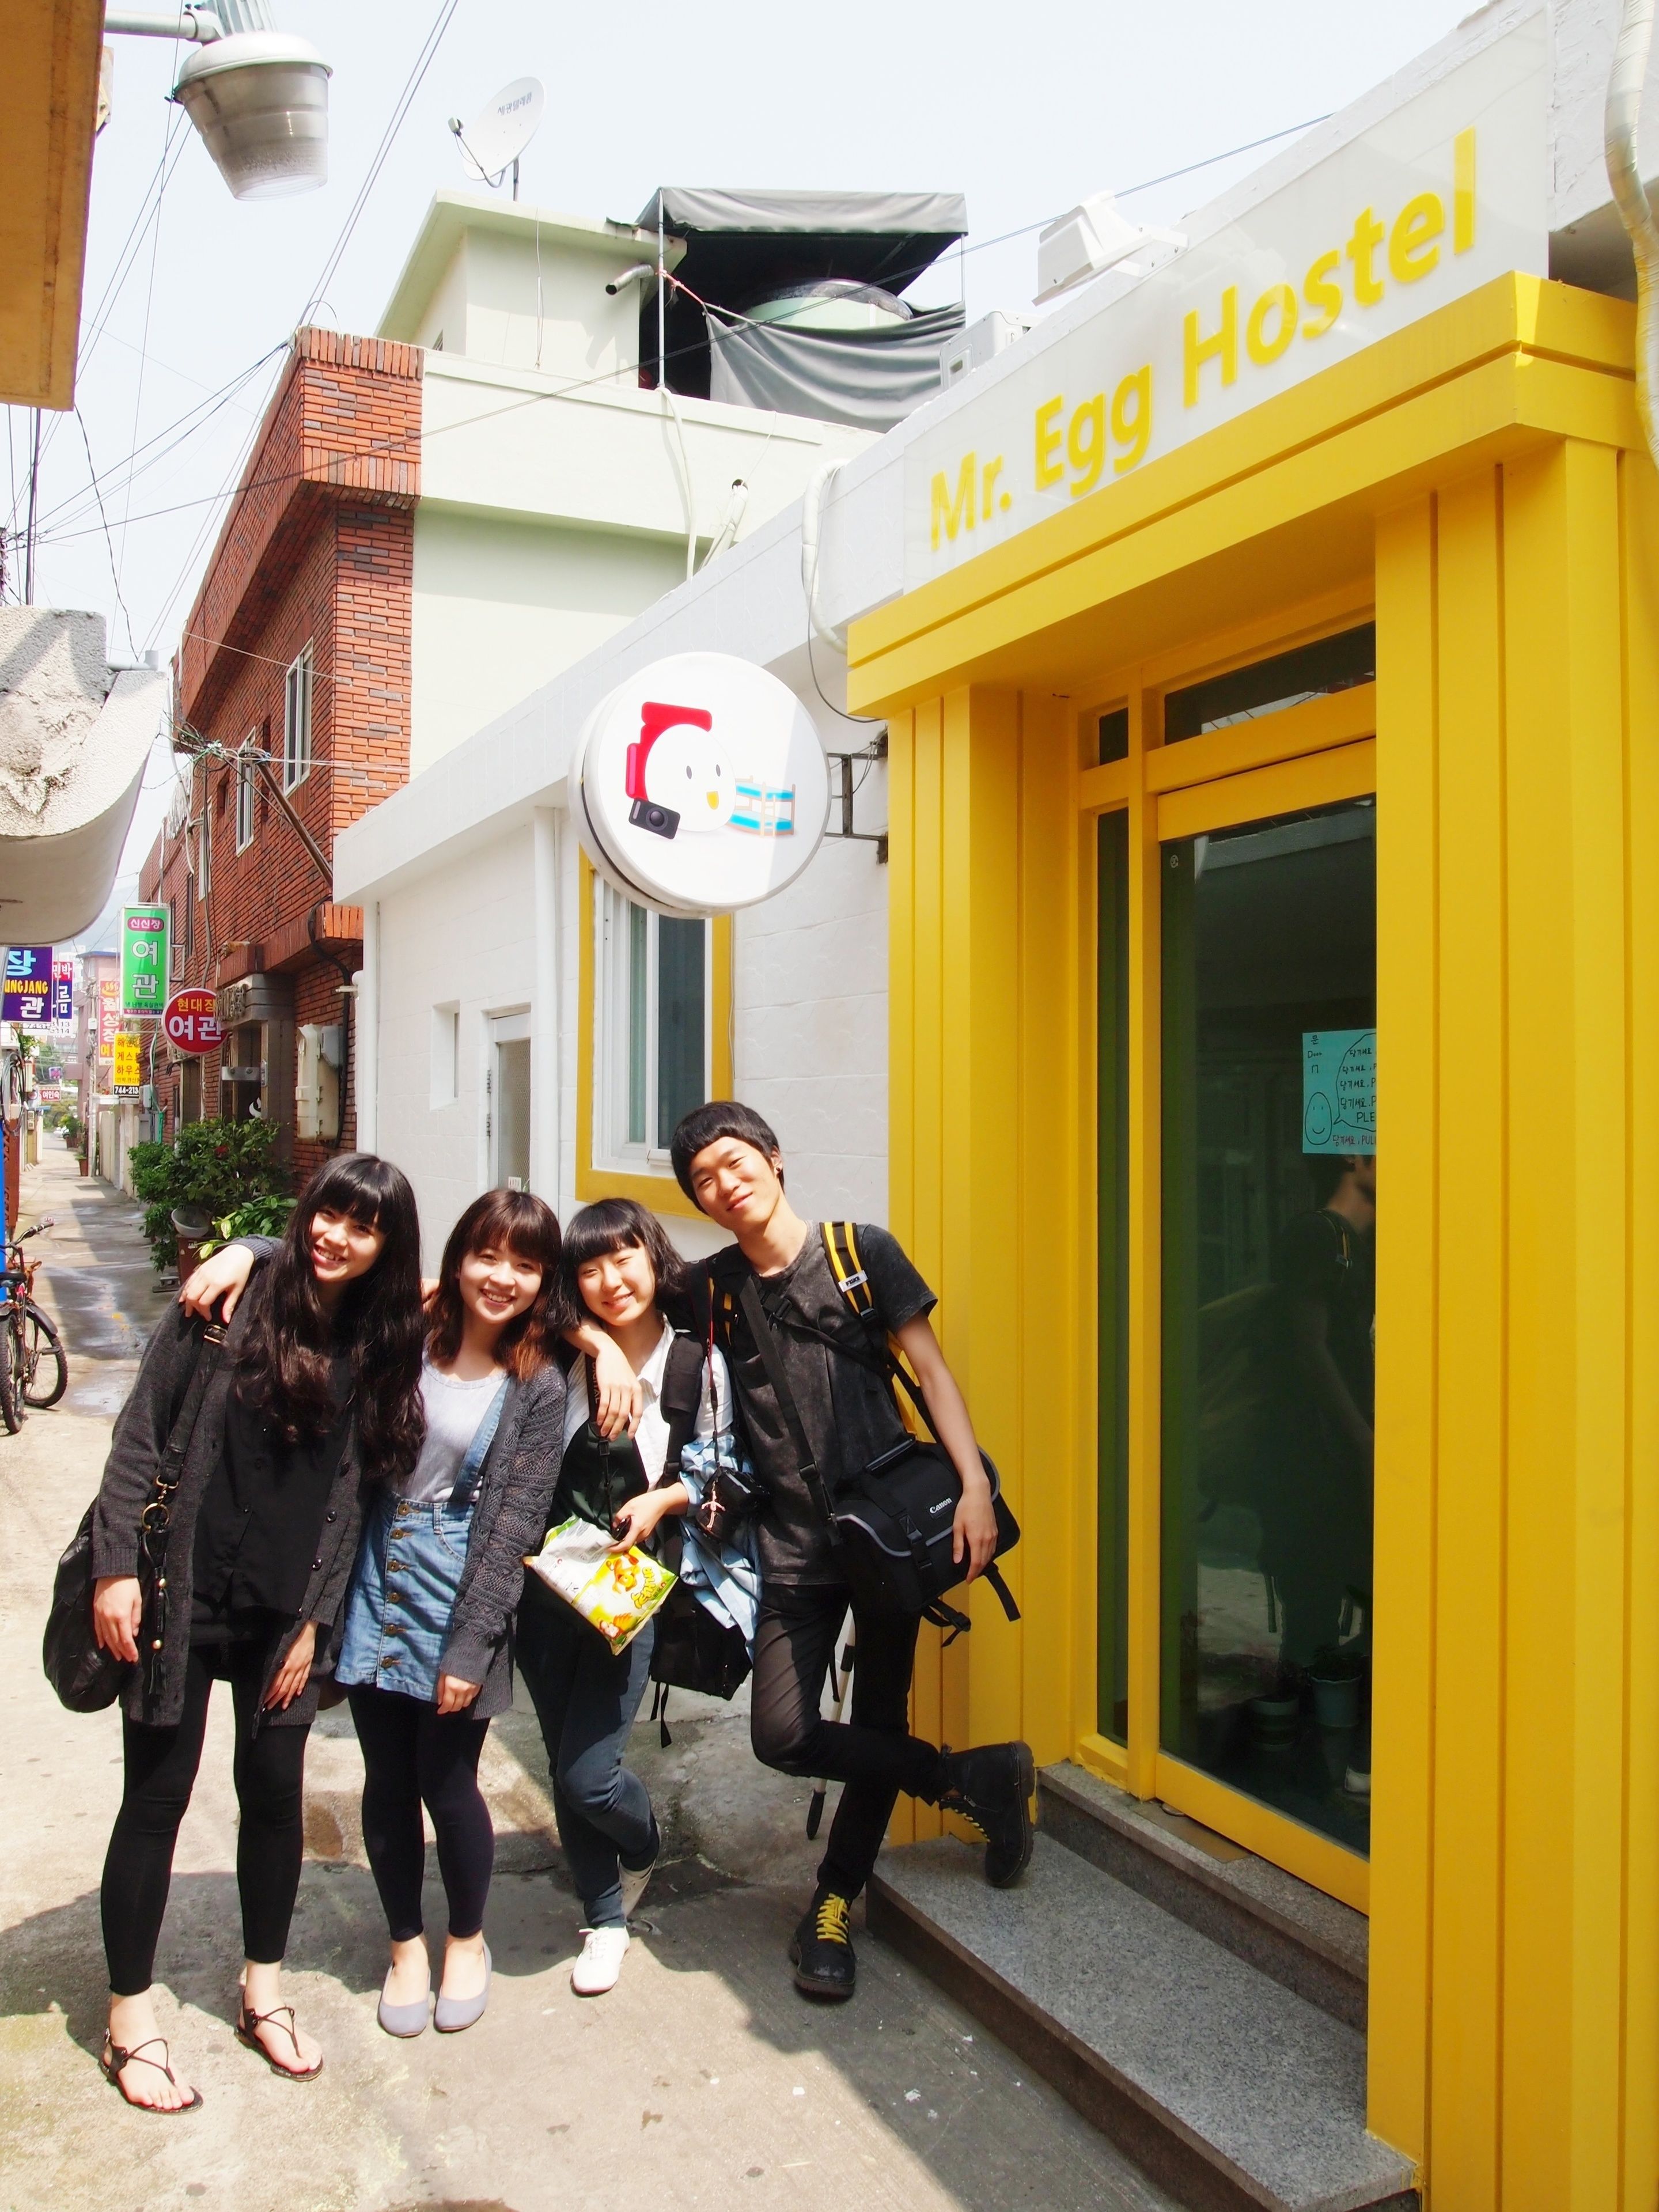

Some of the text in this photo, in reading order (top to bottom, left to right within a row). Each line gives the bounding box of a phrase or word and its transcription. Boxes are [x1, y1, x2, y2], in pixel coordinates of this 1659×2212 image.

[931, 123, 1475, 552] Mr. Egg Hostel
[130, 918, 161, 929] 신신장
[131, 940, 159, 999] 여관
[20, 997, 44, 1018] 관
[177, 997, 216, 1012] 현대장
[169, 1015, 221, 1041] 여관
[1310, 1035, 1319, 1044] 문
[42, 1090, 60, 1099] 여인숙
[929, 1497, 952, 1514] Canon
